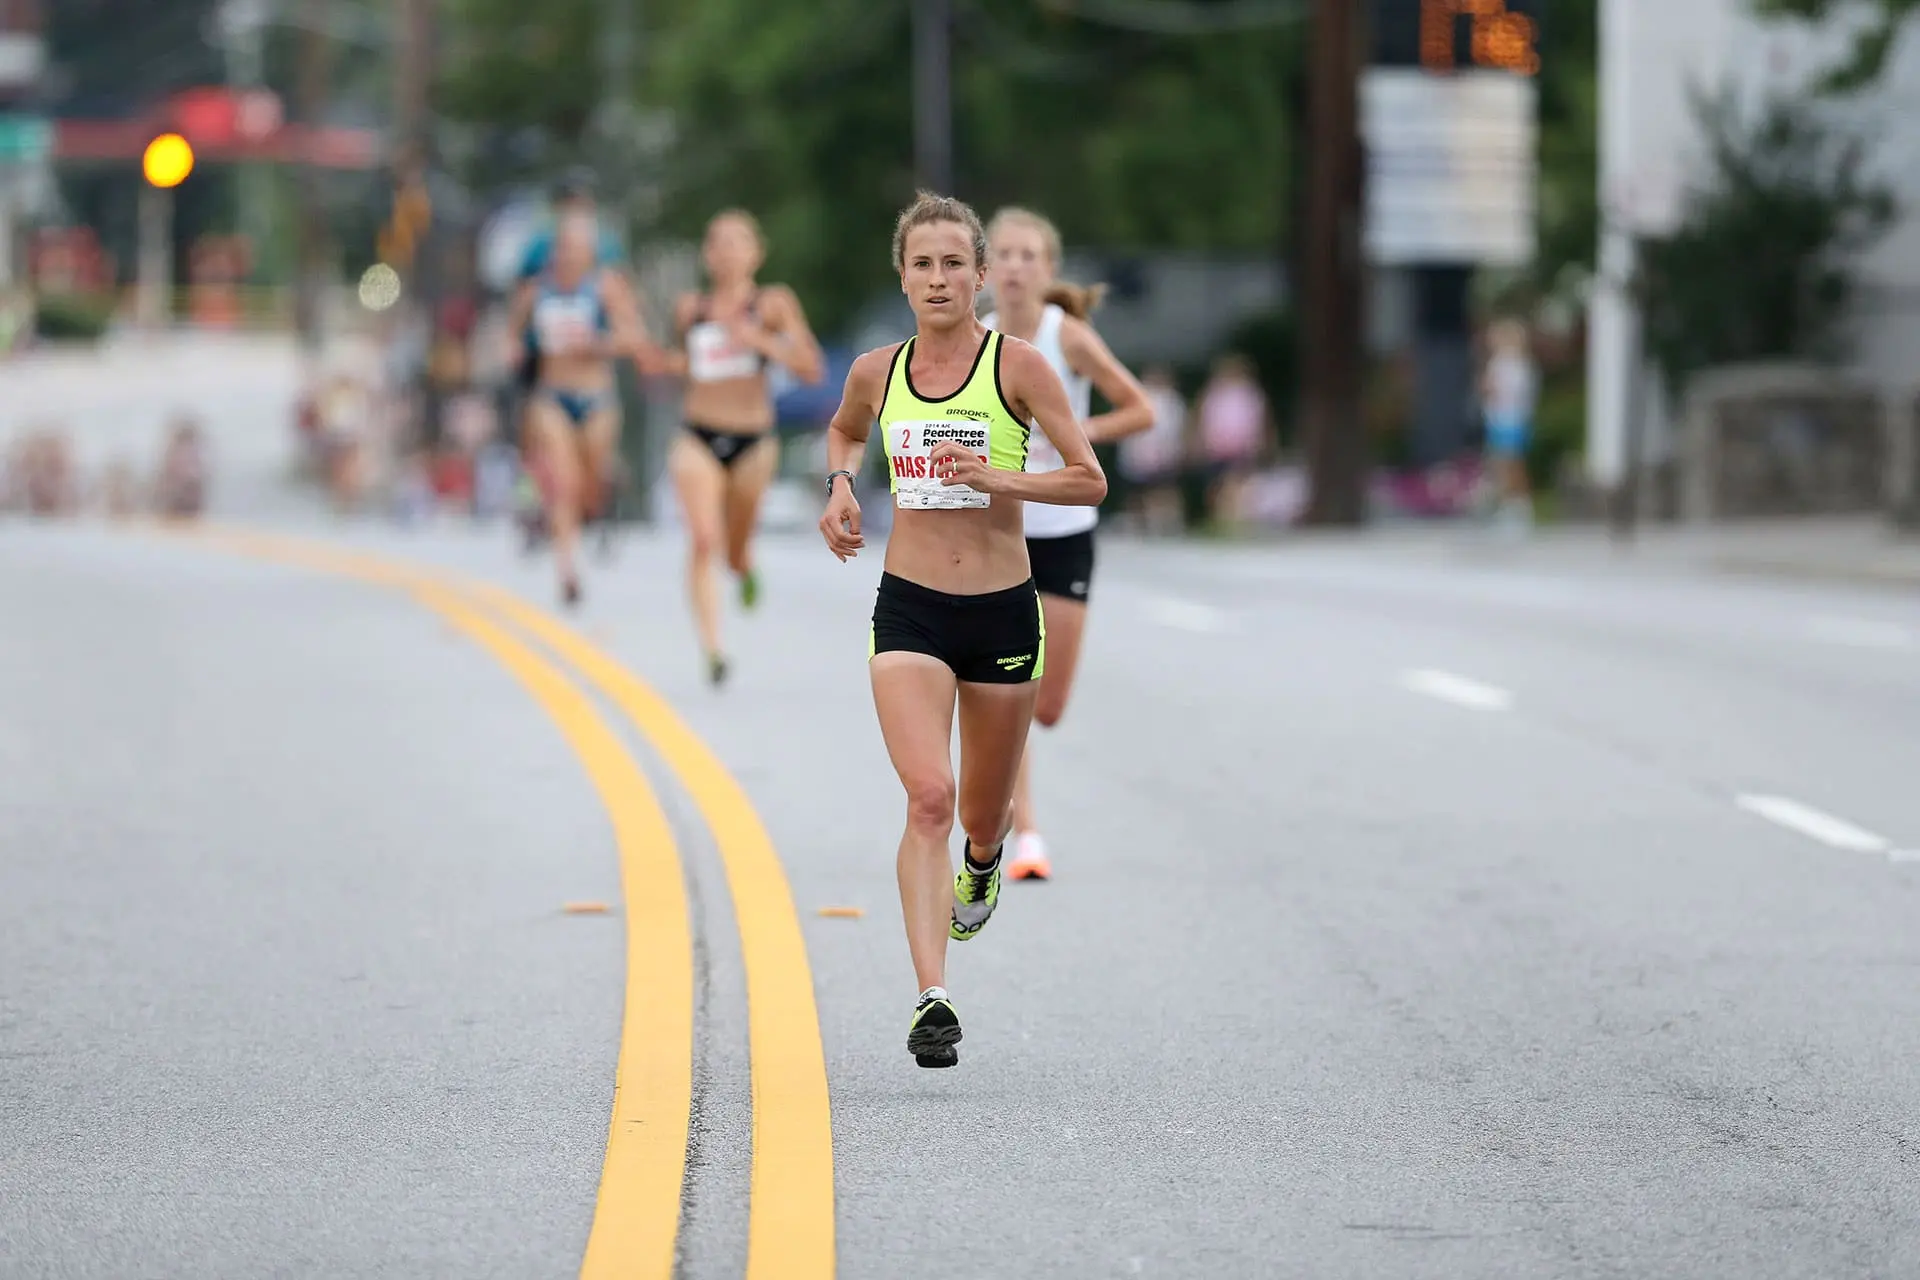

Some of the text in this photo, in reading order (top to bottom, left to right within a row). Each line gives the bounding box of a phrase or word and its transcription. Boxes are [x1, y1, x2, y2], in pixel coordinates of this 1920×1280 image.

[946, 409, 990, 418] BROOKS
[923, 428, 985, 438] Peachtree
[902, 429, 911, 449] 2
[996, 653, 1032, 664] BROOKS
